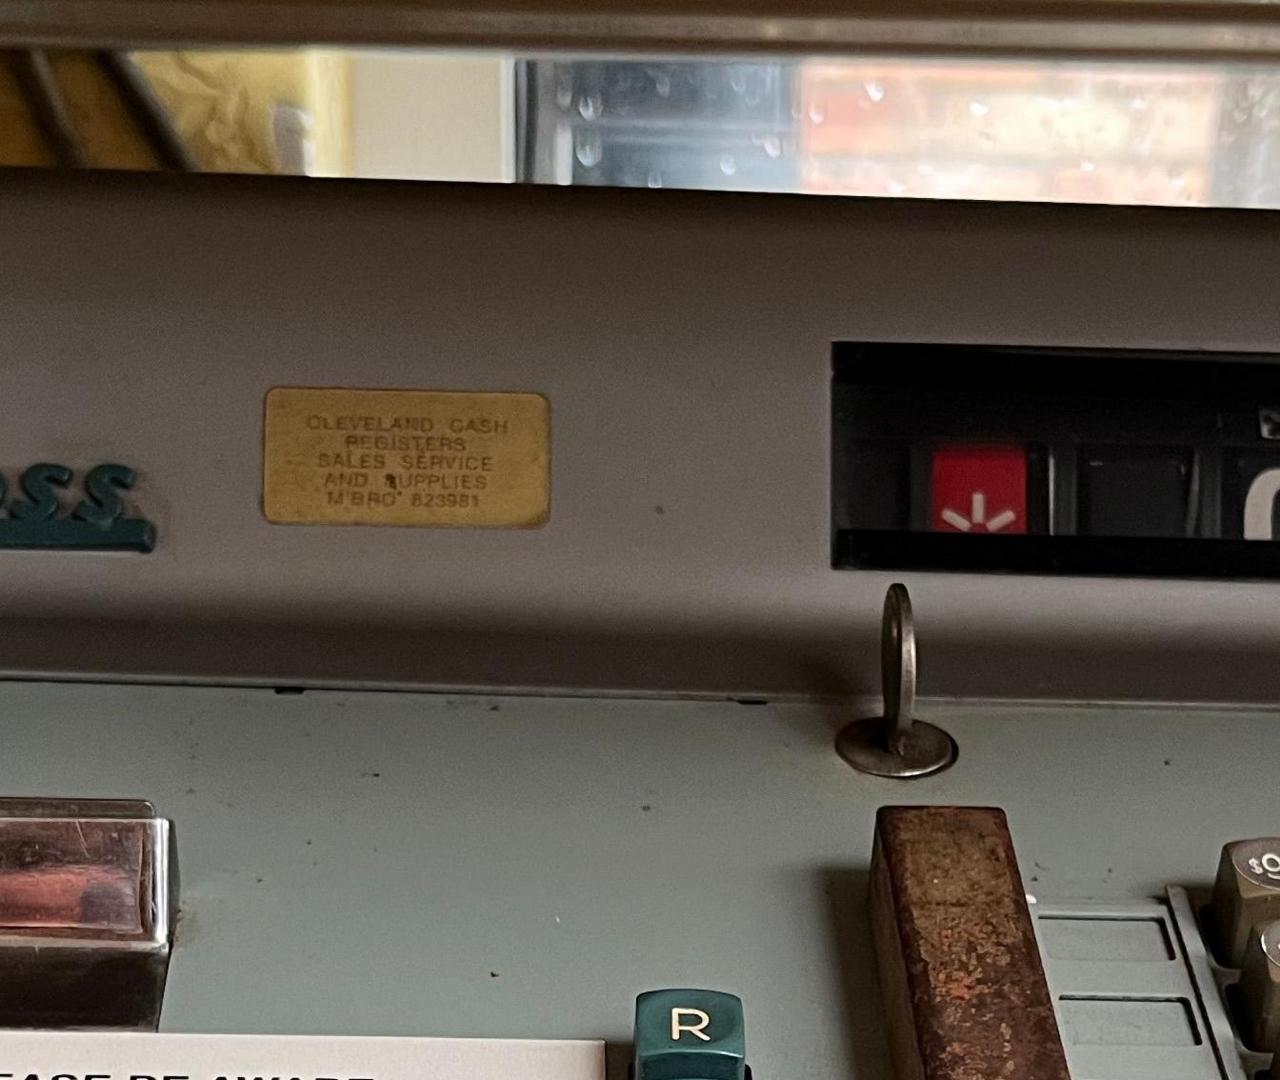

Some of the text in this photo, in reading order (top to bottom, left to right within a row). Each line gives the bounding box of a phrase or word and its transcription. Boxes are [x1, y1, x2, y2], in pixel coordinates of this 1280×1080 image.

[345, 434, 466, 451] REGISTERS
[318, 453, 494, 471] SALES SERVICE
[324, 473, 369, 487] AND
[671, 1007, 711, 1041] R
